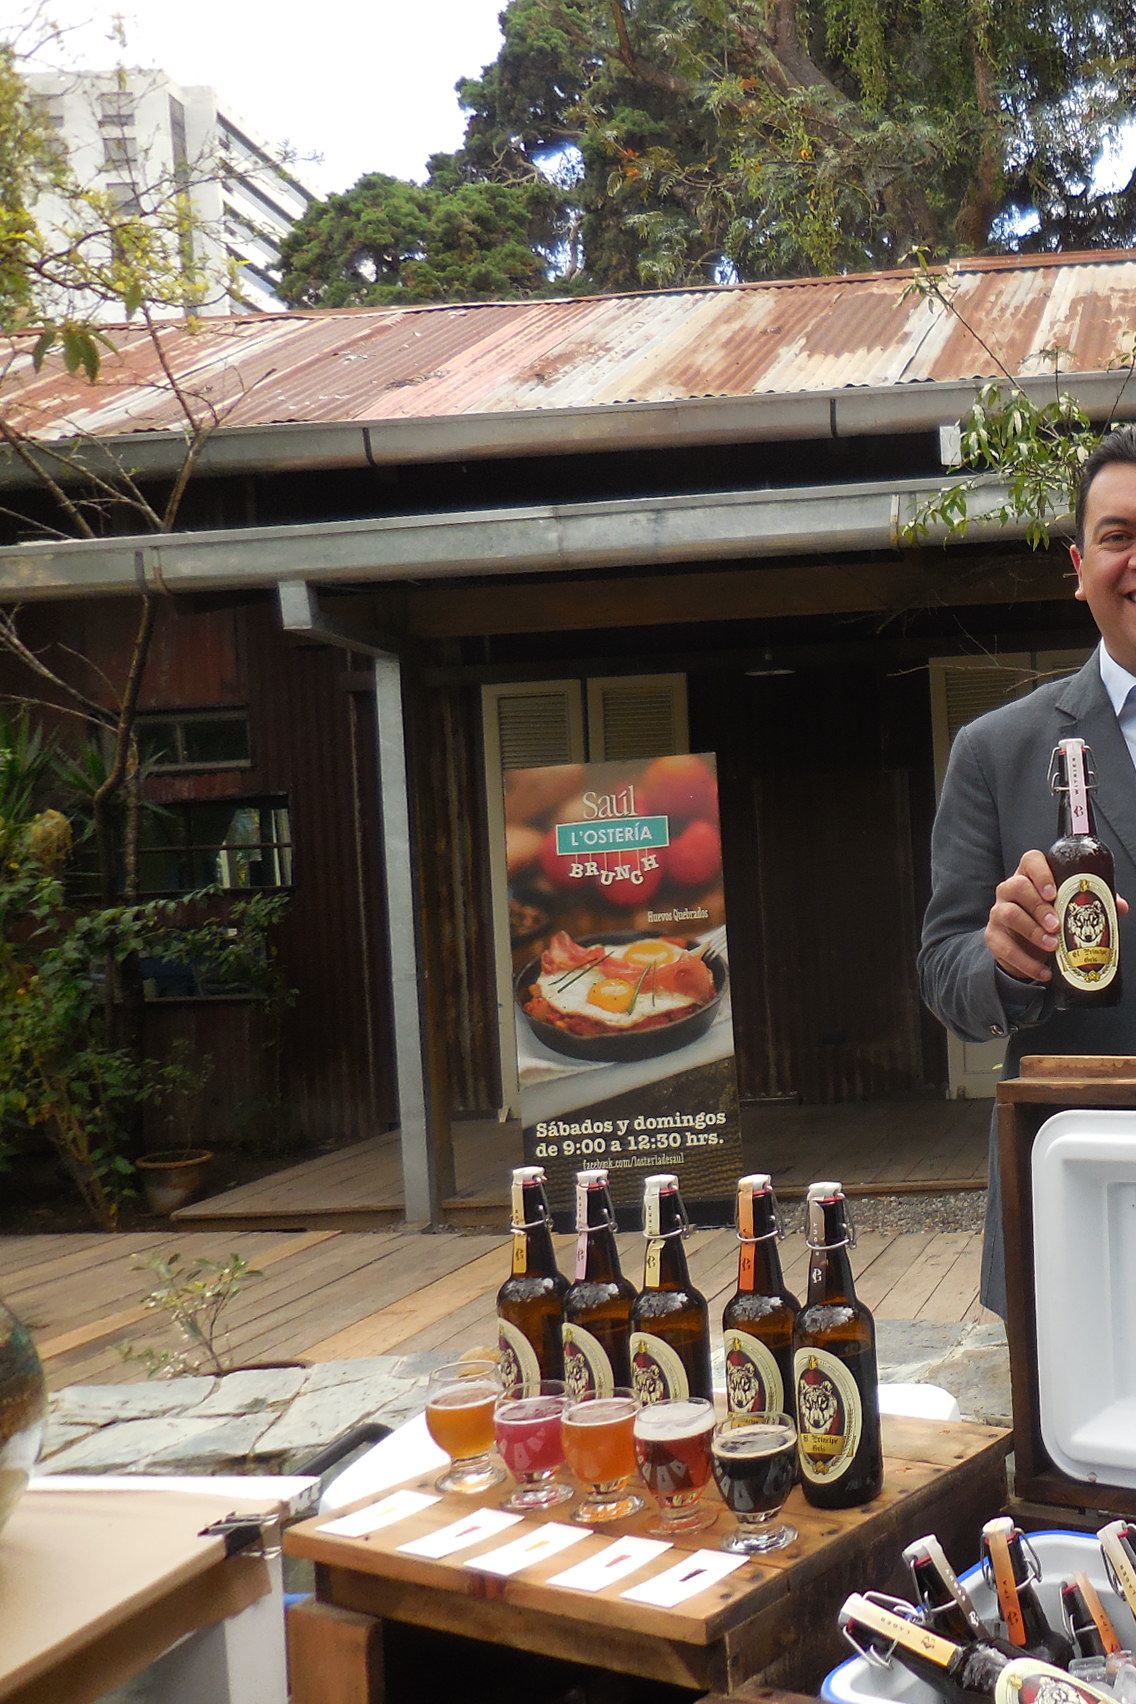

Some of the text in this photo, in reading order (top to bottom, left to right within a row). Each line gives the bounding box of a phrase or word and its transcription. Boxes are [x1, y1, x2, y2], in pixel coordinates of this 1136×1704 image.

[582, 785, 638, 819] Saúl
[572, 824, 653, 846] L'OSTERÍA
[569, 855, 660, 886] BRUNCH
[647, 907, 709, 923] Huevos Quebrados
[536, 1111, 727, 1138] Sábados y domingos
[536, 1132, 725, 1157] de 9:00 a 12:30 hrs.
[1119, 1563, 1136, 1595] LAGER
[880, 1616, 911, 1634] LAGER
